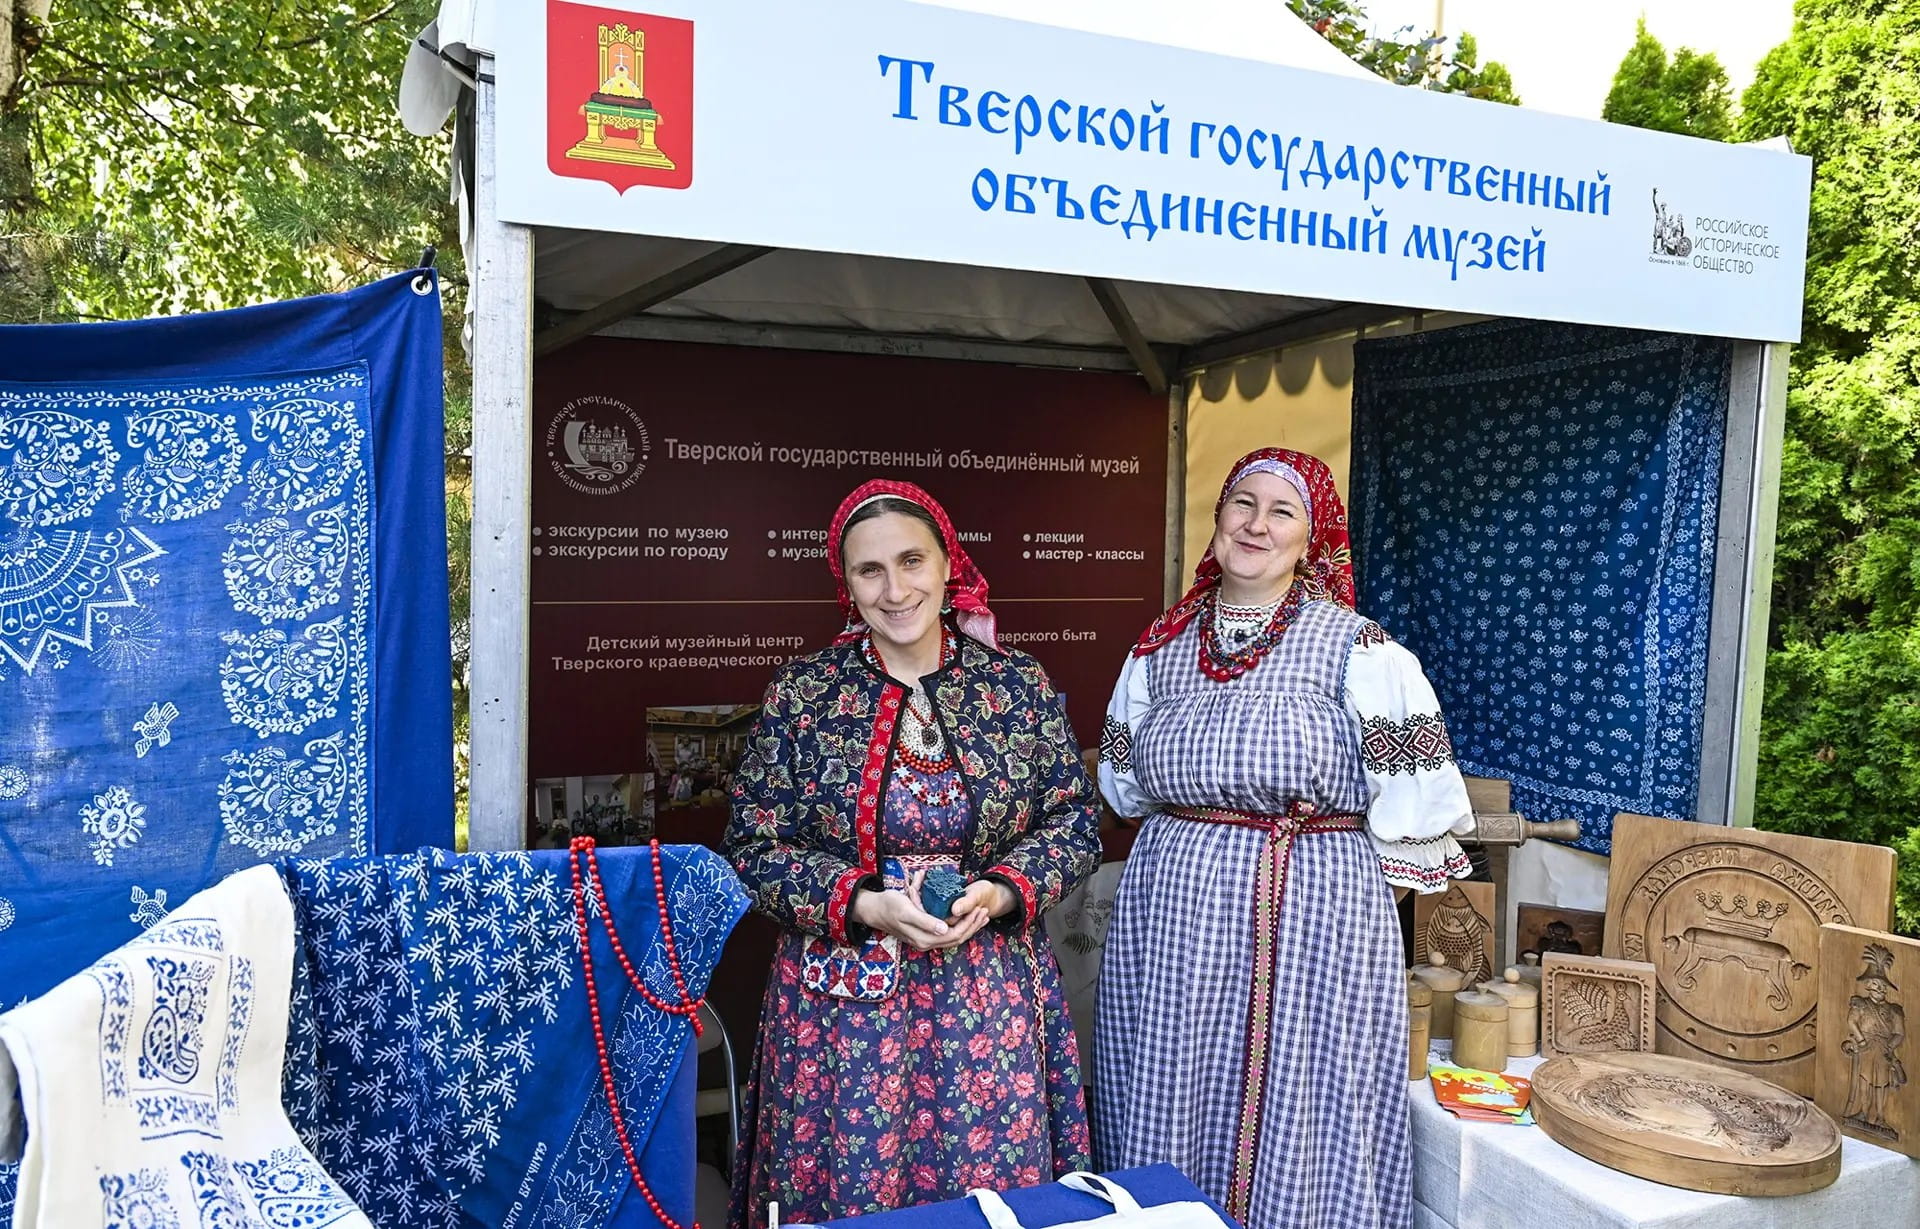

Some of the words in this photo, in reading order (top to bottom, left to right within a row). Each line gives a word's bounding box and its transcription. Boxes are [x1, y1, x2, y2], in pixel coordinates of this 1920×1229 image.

[1190, 122, 1611, 216] государственный
[1696, 216, 1769, 239] РОССИЙСКОЕ
[1403, 224, 1546, 281] музей
[1694, 236, 1780, 259] ИСТОРИЧЕСКОЕ
[1693, 255, 1754, 275] ОБЩЕСТВО
[664, 438, 763, 465] Тверской
[769, 446, 943, 469] государственный
[948, 450, 1085, 473] объединённый
[1091, 456, 1140, 477] музей
[548, 526, 639, 541] экскурсии
[648, 527, 669, 538] по
[675, 527, 729, 541] музею
[782, 529, 828, 543] интер
[957, 531, 992, 542] ммы
[1034, 532, 1085, 546] лекции
[548, 545, 639, 560] экскурсии
[644, 546, 665, 557] по
[670, 546, 729, 560] городу
[782, 545, 829, 561] музей
[1035, 550, 1084, 562] мастер
[1095, 549, 1145, 561] классы
[587, 635, 660, 652] Детский
[665, 633, 751, 652] музейный
[756, 636, 804, 649] центр
[997, 630, 1059, 645] верского
[1062, 629, 1097, 641] быта
[552, 656, 644, 672] Тверского
[649, 654, 783, 672] краеведческого
